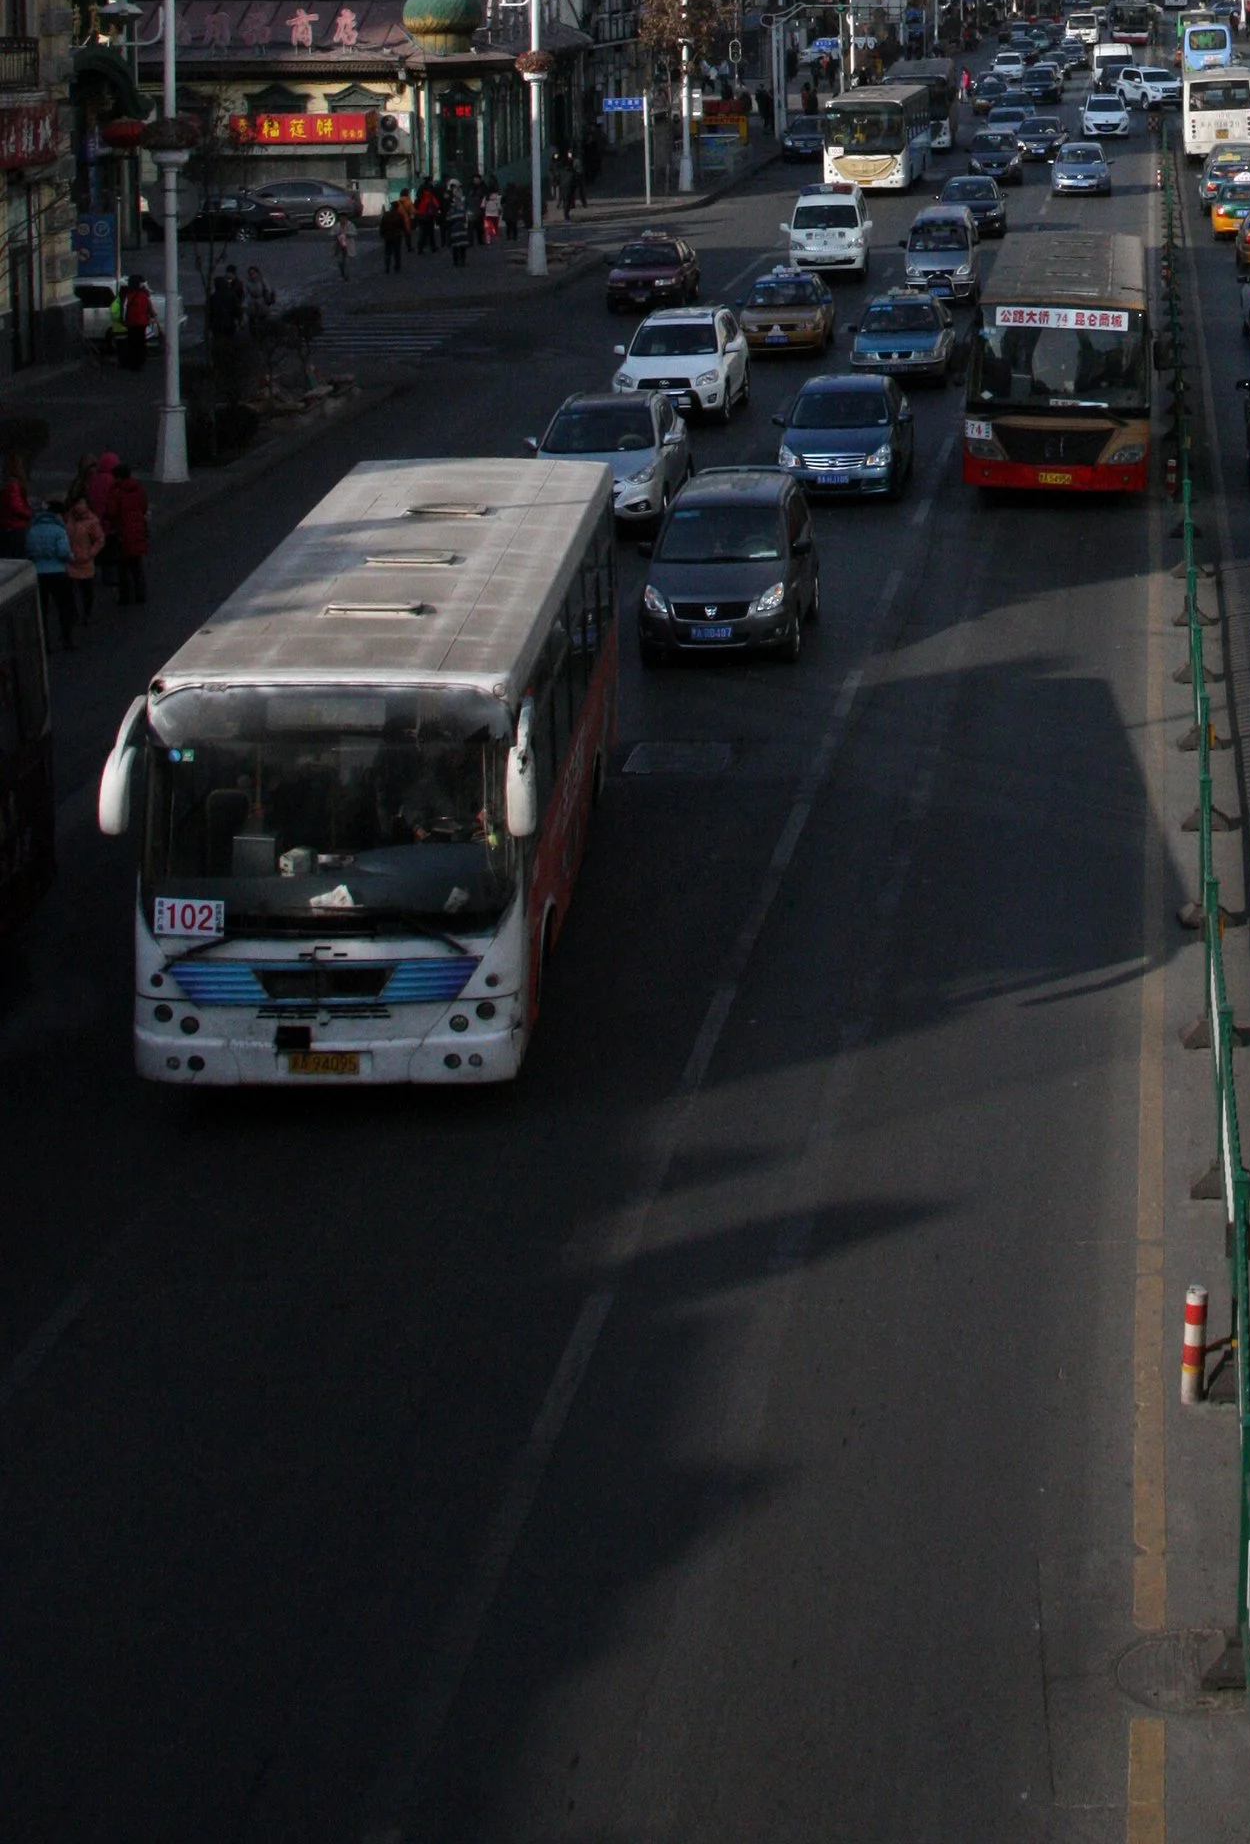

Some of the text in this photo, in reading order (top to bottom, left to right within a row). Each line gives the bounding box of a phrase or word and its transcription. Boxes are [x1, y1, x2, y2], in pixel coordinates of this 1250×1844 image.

[1001, 310, 1122, 327] 公路大桥 74 昆仑商城
[166, 903, 213, 931] 102
